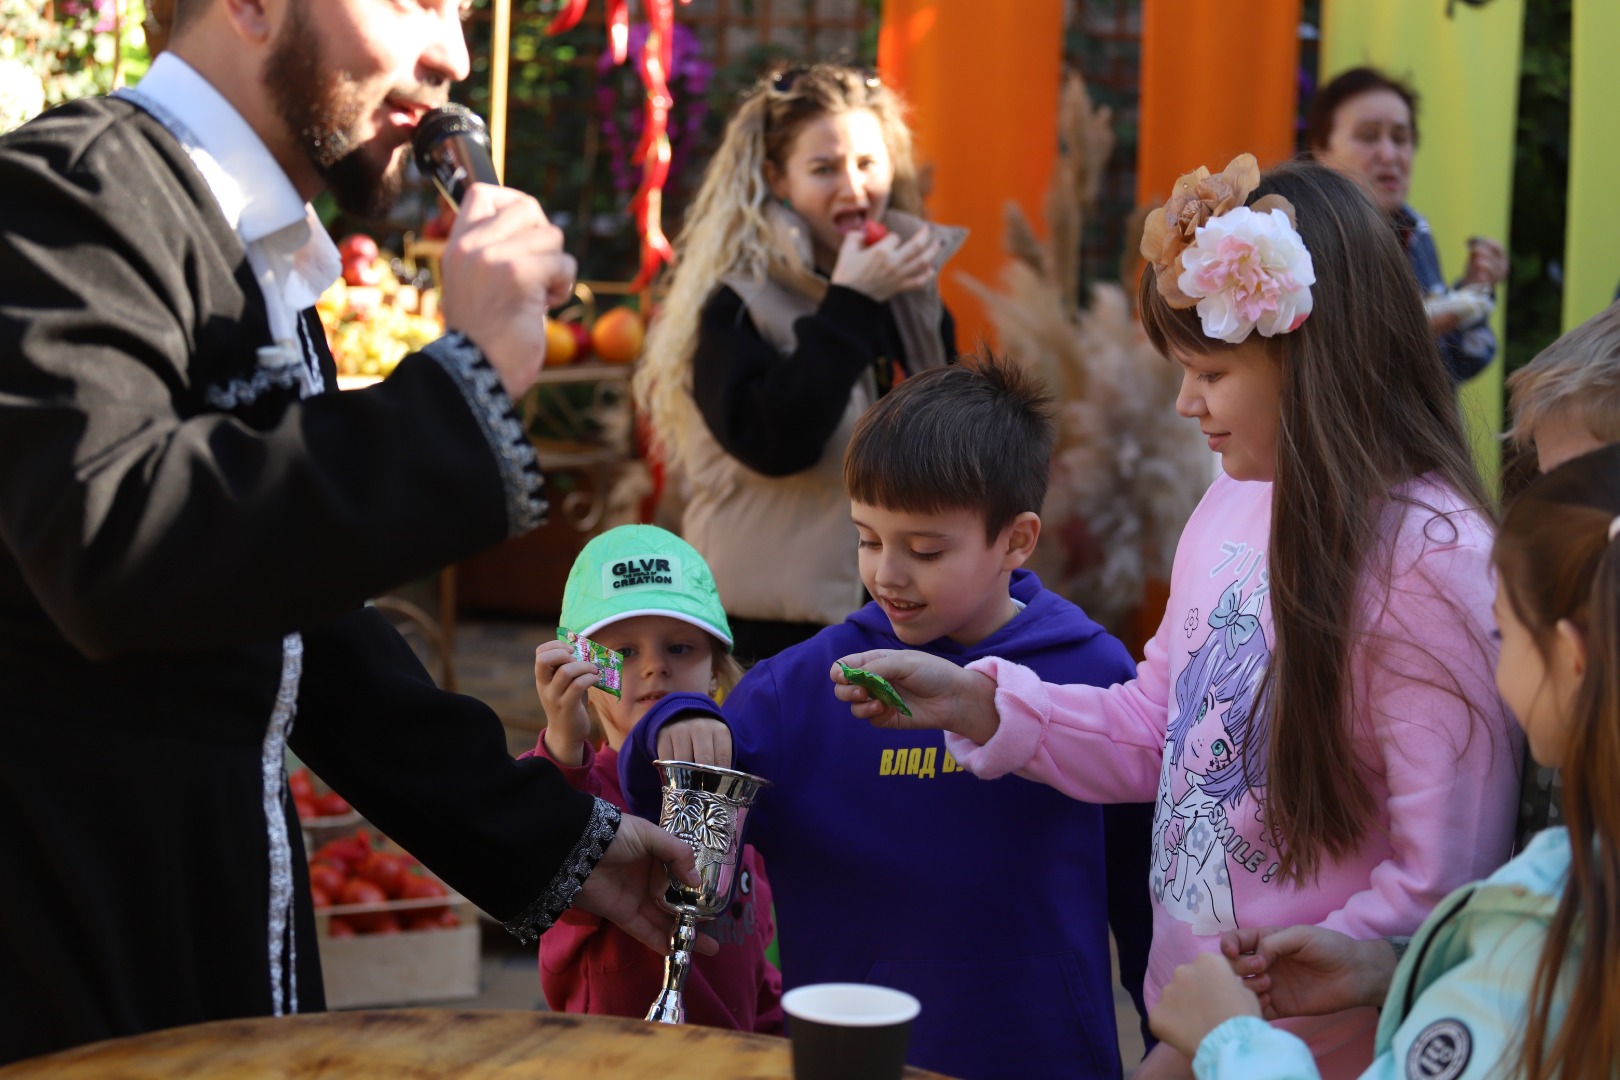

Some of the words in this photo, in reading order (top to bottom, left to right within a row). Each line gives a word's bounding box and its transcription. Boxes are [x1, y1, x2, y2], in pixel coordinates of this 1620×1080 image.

[612, 559, 671, 576] GLVR
[613, 575, 672, 589] CREATION
[879, 747, 938, 779] ВЛАД
